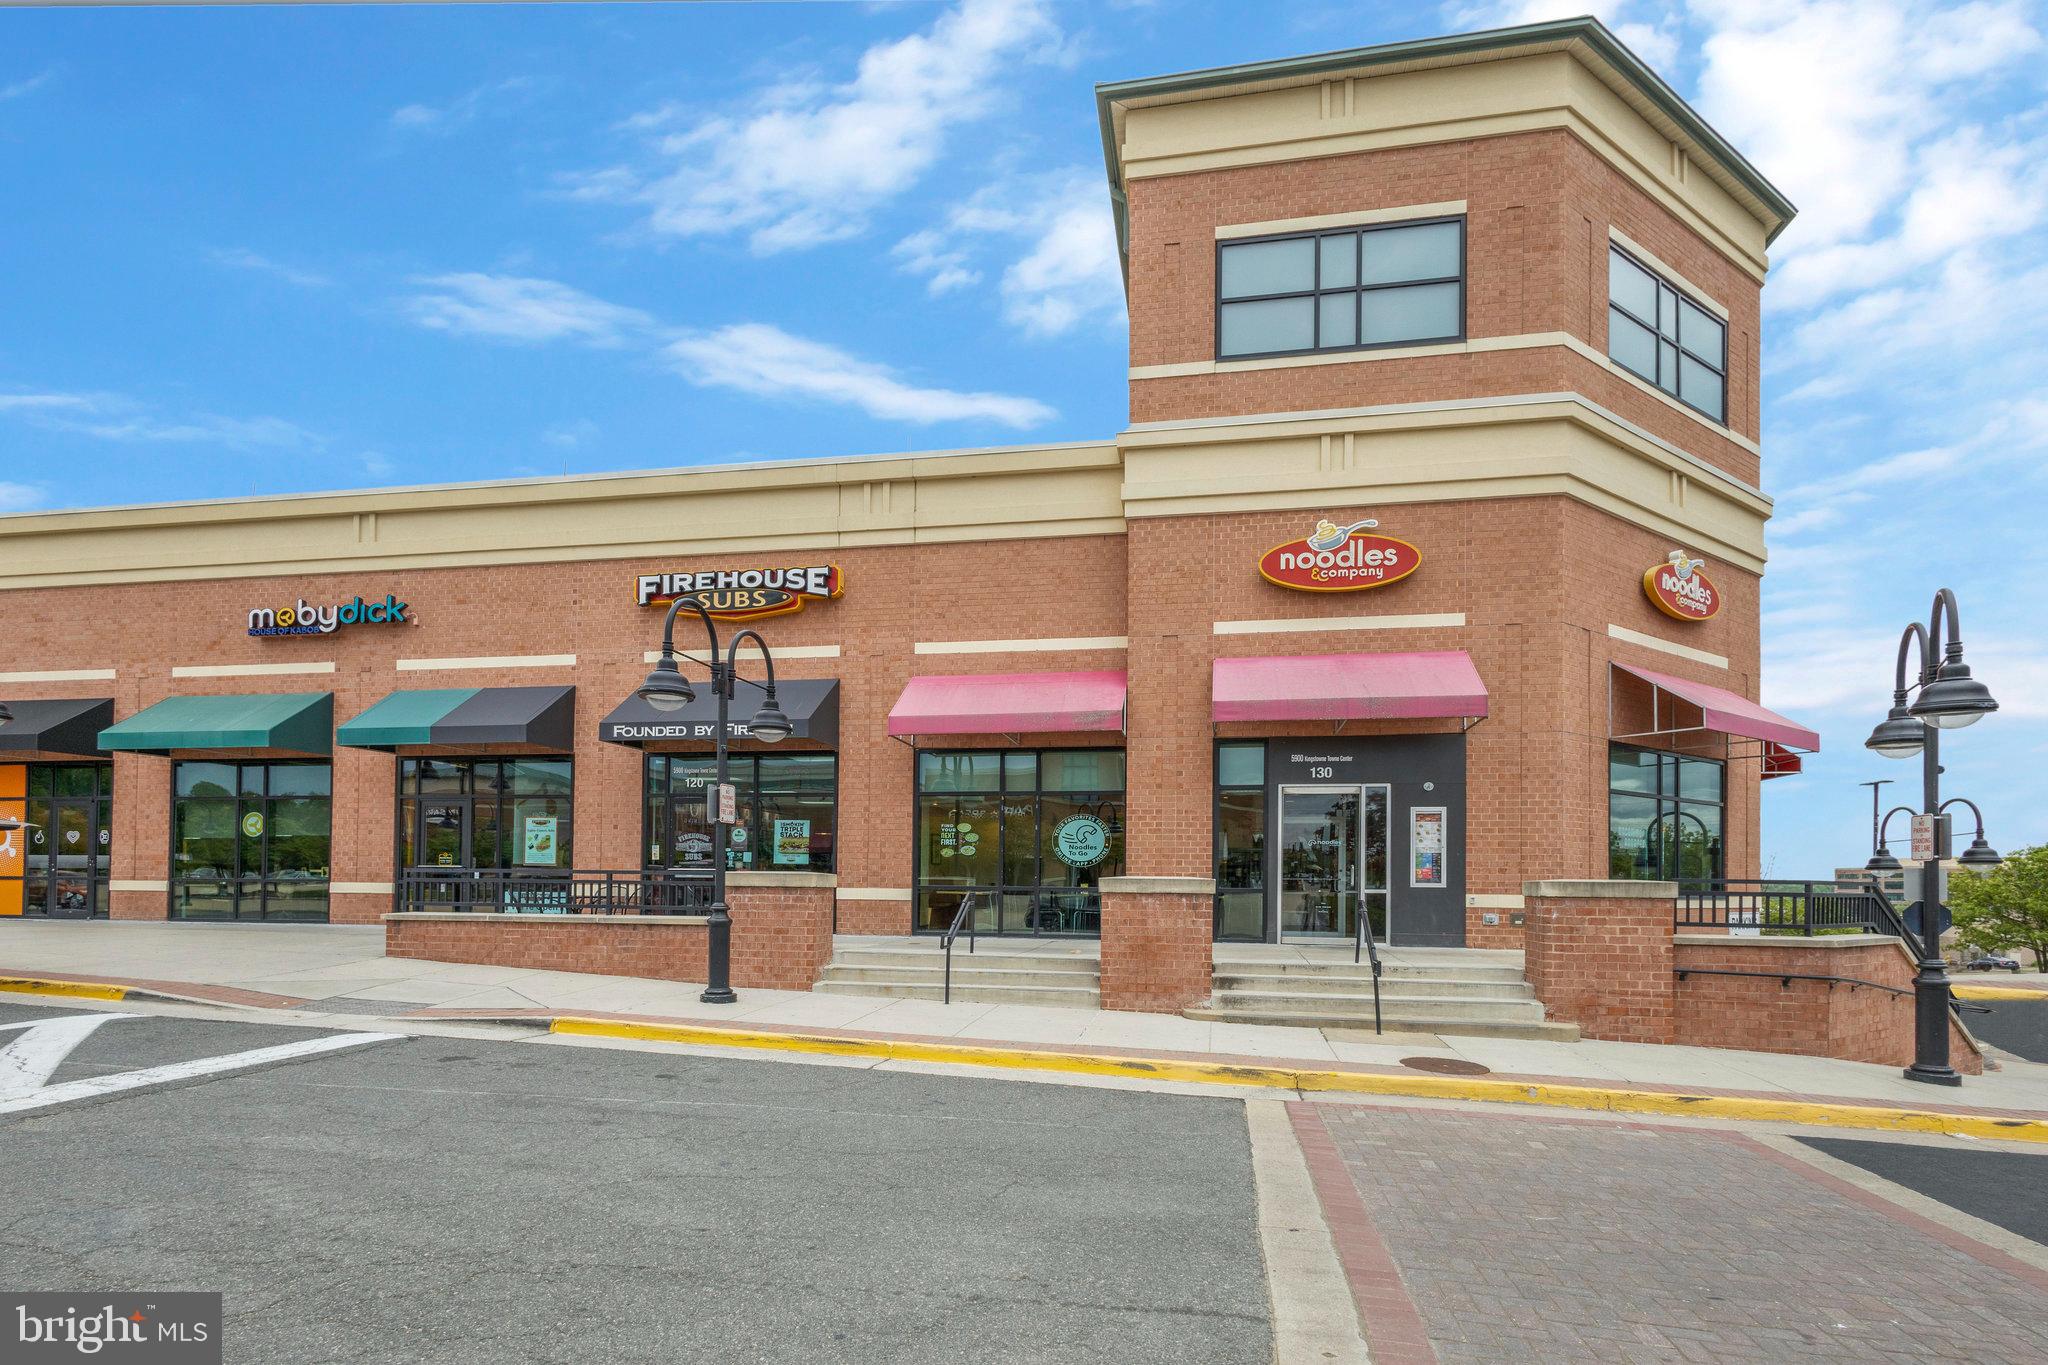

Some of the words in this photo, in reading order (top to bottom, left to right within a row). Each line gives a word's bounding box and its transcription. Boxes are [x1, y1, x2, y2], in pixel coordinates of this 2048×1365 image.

[1280, 539, 1398, 570] noodles
[638, 566, 829, 605] FIREHOUSE
[1662, 573, 1712, 605] noodles
[698, 590, 767, 609] SUBS
[248, 628, 277, 636] HOUSE
[613, 725, 687, 738] FOUNDED
[694, 725, 715, 736] BY
[1310, 767, 1333, 778] 130
[685, 778, 704, 788] 120
